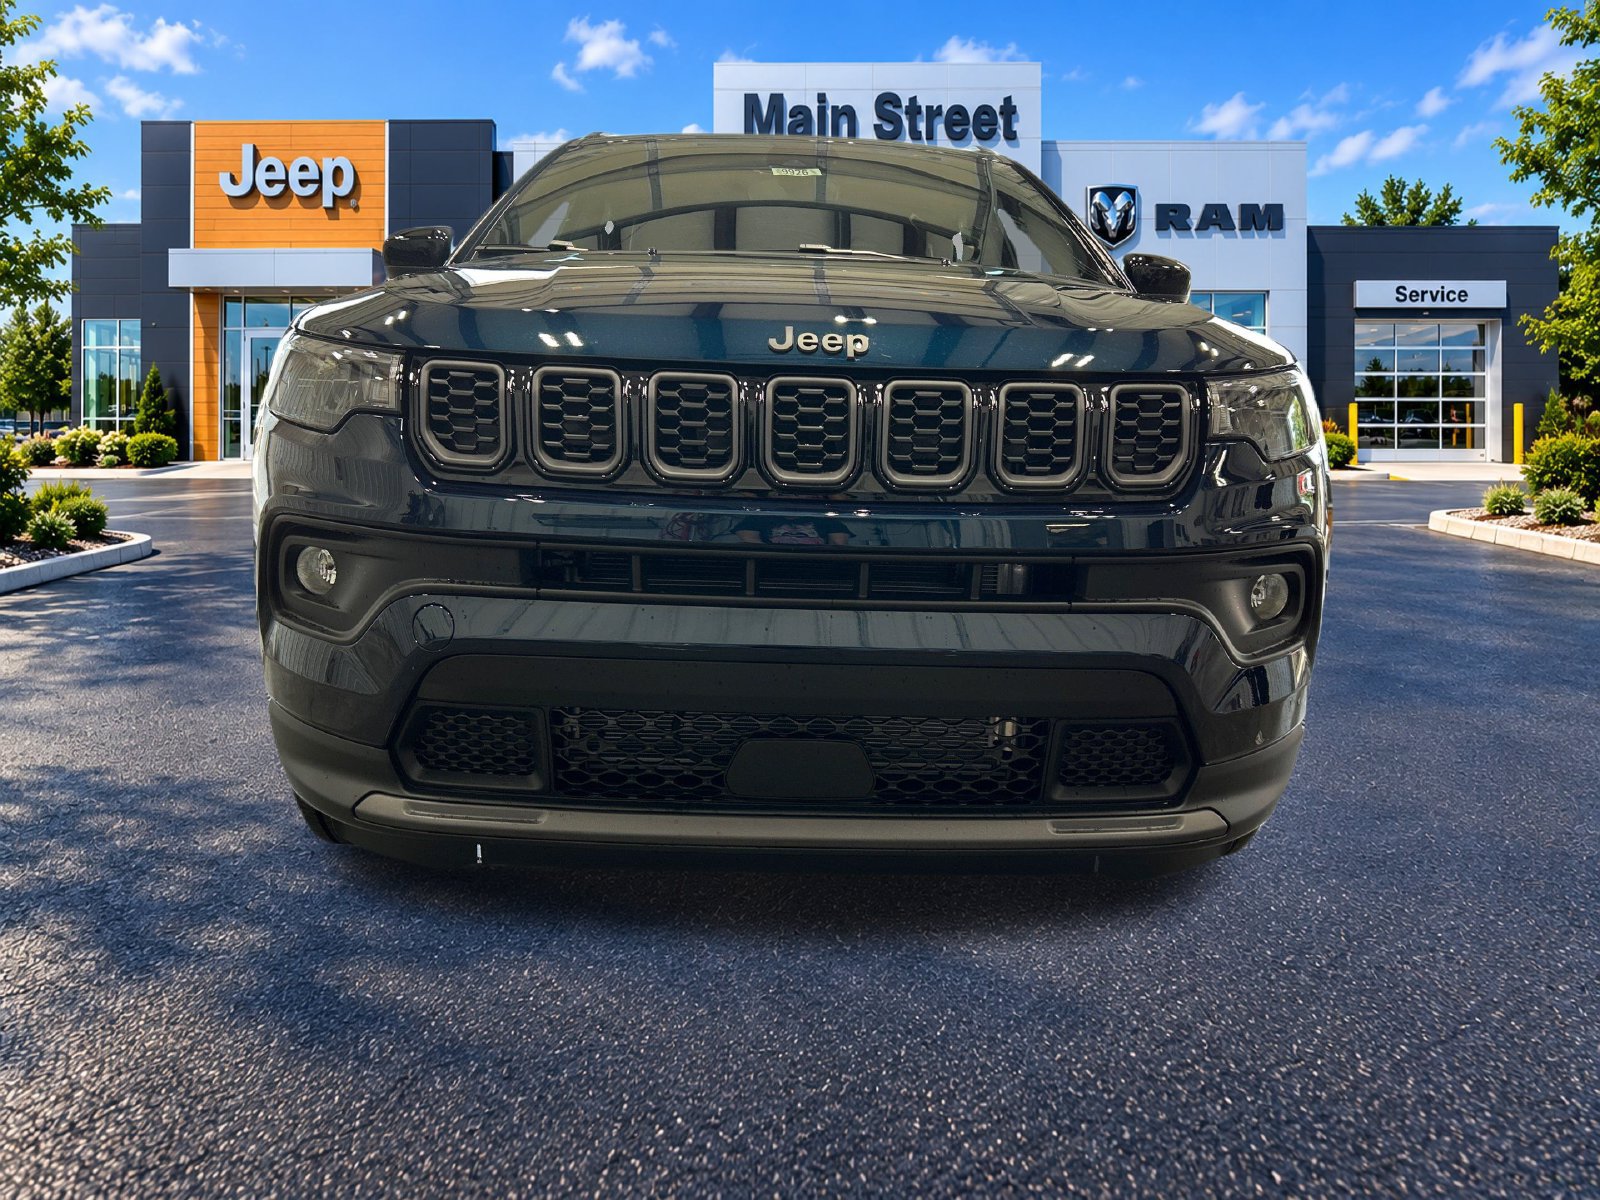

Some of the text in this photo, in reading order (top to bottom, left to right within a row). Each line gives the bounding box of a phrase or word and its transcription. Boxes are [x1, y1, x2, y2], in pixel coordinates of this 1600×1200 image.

[744, 92, 1017, 140] Main Street
[219, 143, 355, 208] Jeep
[1155, 203, 1284, 231] RAM
[1395, 285, 1469, 303] Service
[768, 325, 870, 360] Jeep
